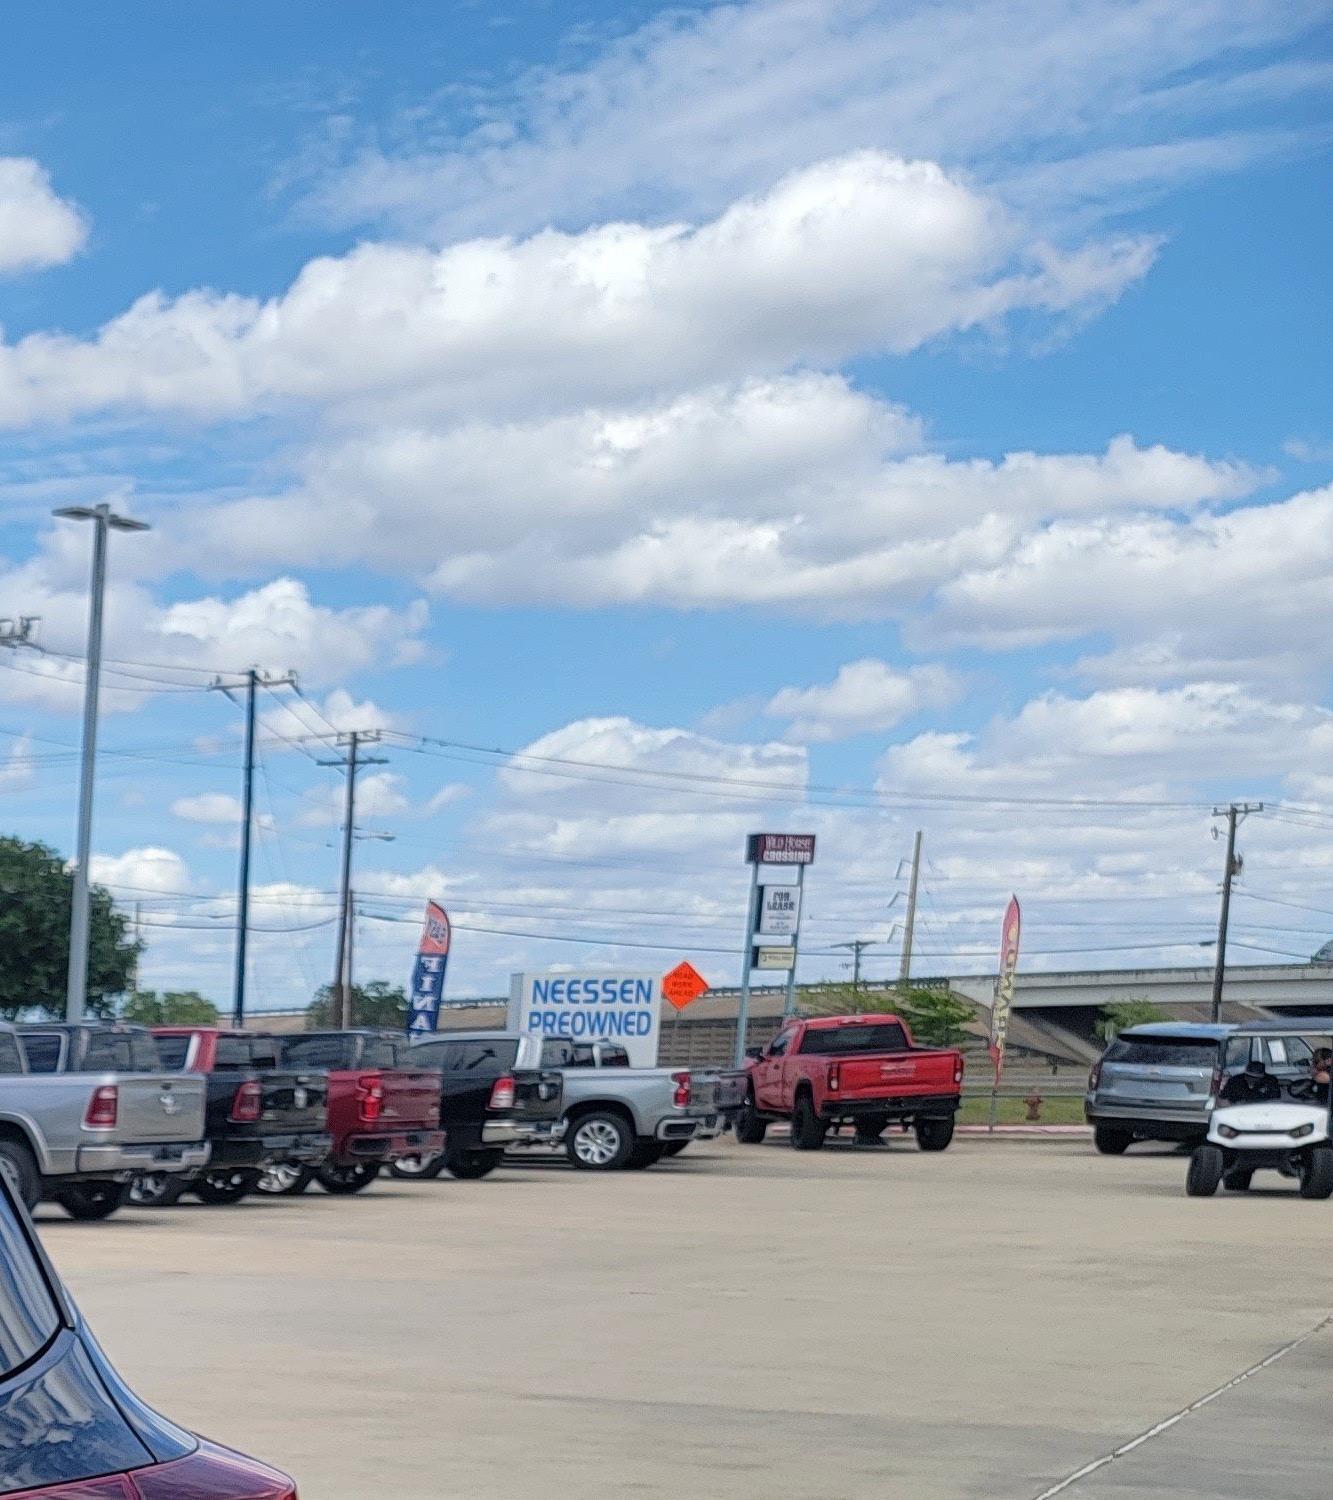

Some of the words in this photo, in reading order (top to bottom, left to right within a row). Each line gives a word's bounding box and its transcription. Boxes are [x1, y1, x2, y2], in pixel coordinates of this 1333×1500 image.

[763, 850, 811, 862] CROSSING
[773, 892, 790, 901] FOR
[767, 901, 795, 911] LEASE
[532, 979, 653, 1004] NEESSEN
[528, 1011, 652, 1036] PREOWNED
